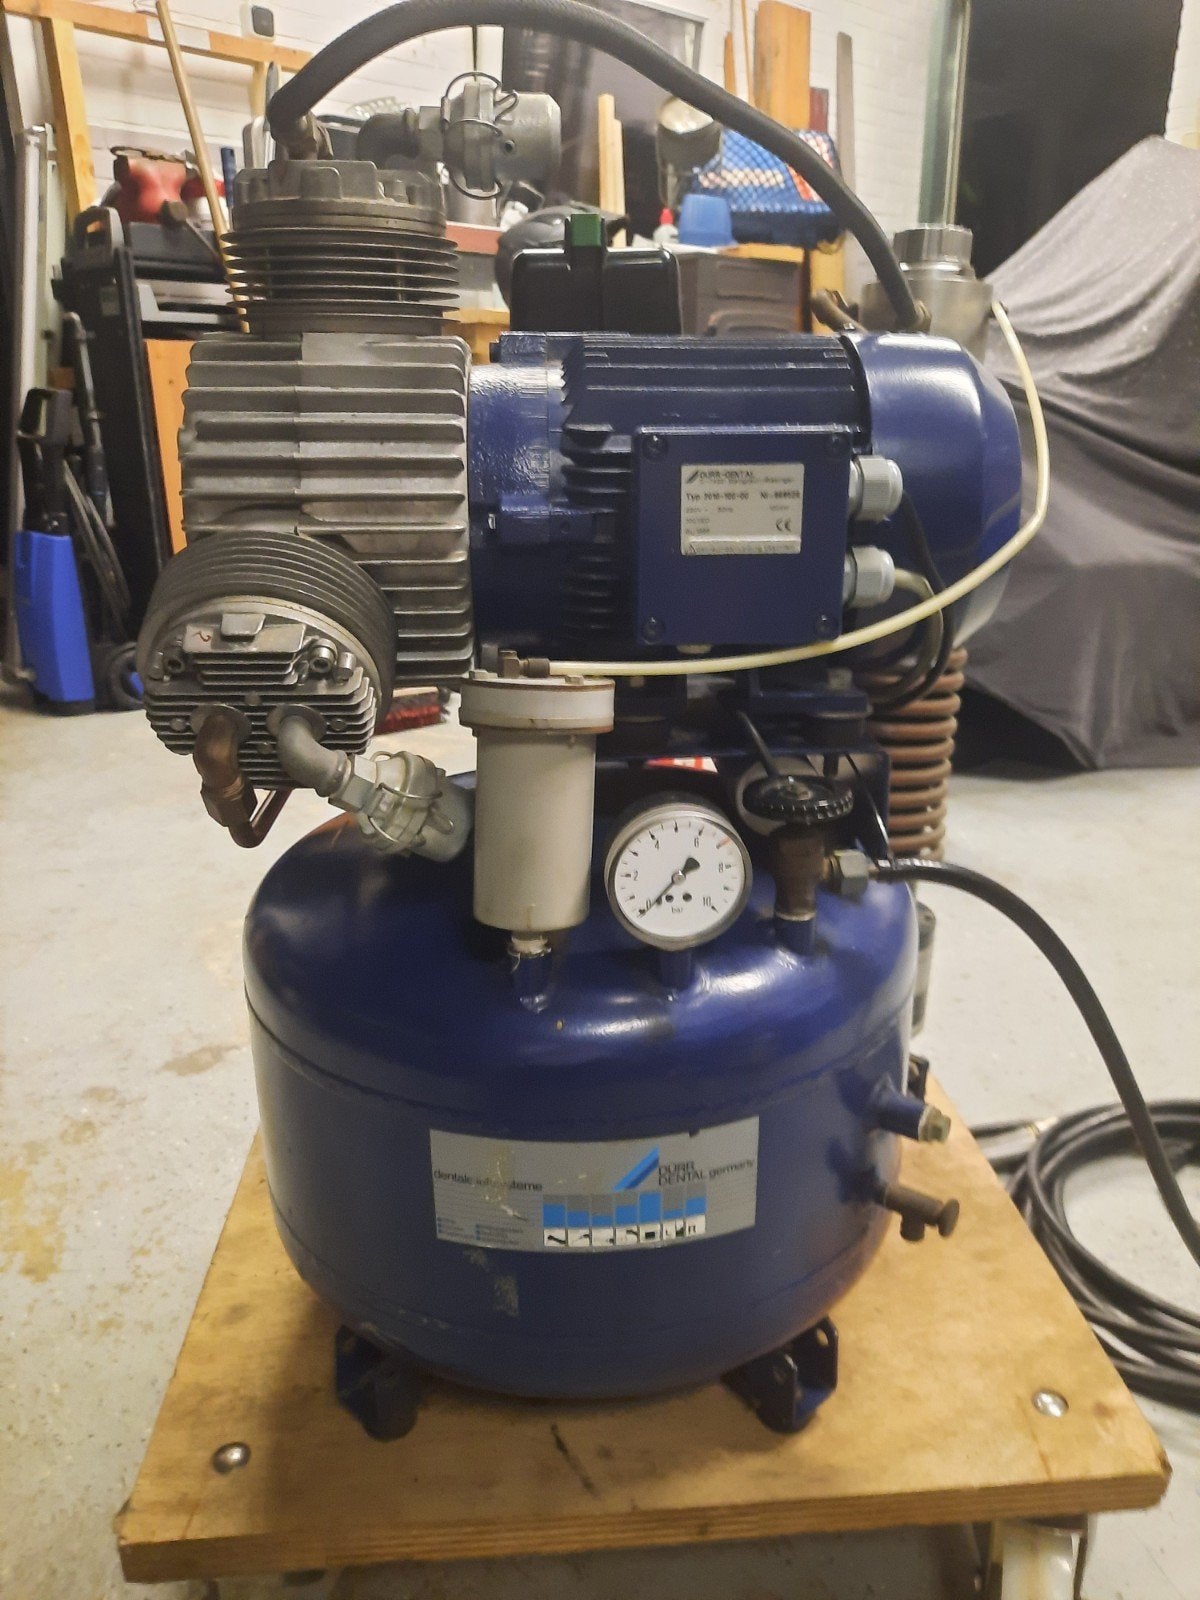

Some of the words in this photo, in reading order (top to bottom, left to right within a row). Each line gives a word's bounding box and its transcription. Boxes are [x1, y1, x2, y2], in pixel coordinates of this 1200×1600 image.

[654, 839, 660, 850] 4
[693, 837, 700, 848] 6
[718, 862, 724, 873] 8
[633, 869, 639, 882] 2
[645, 899, 652, 910] 0
[702, 896, 712, 907] 10
[658, 1169, 705, 1186] DENTAL
[708, 1159, 754, 1180] germany
